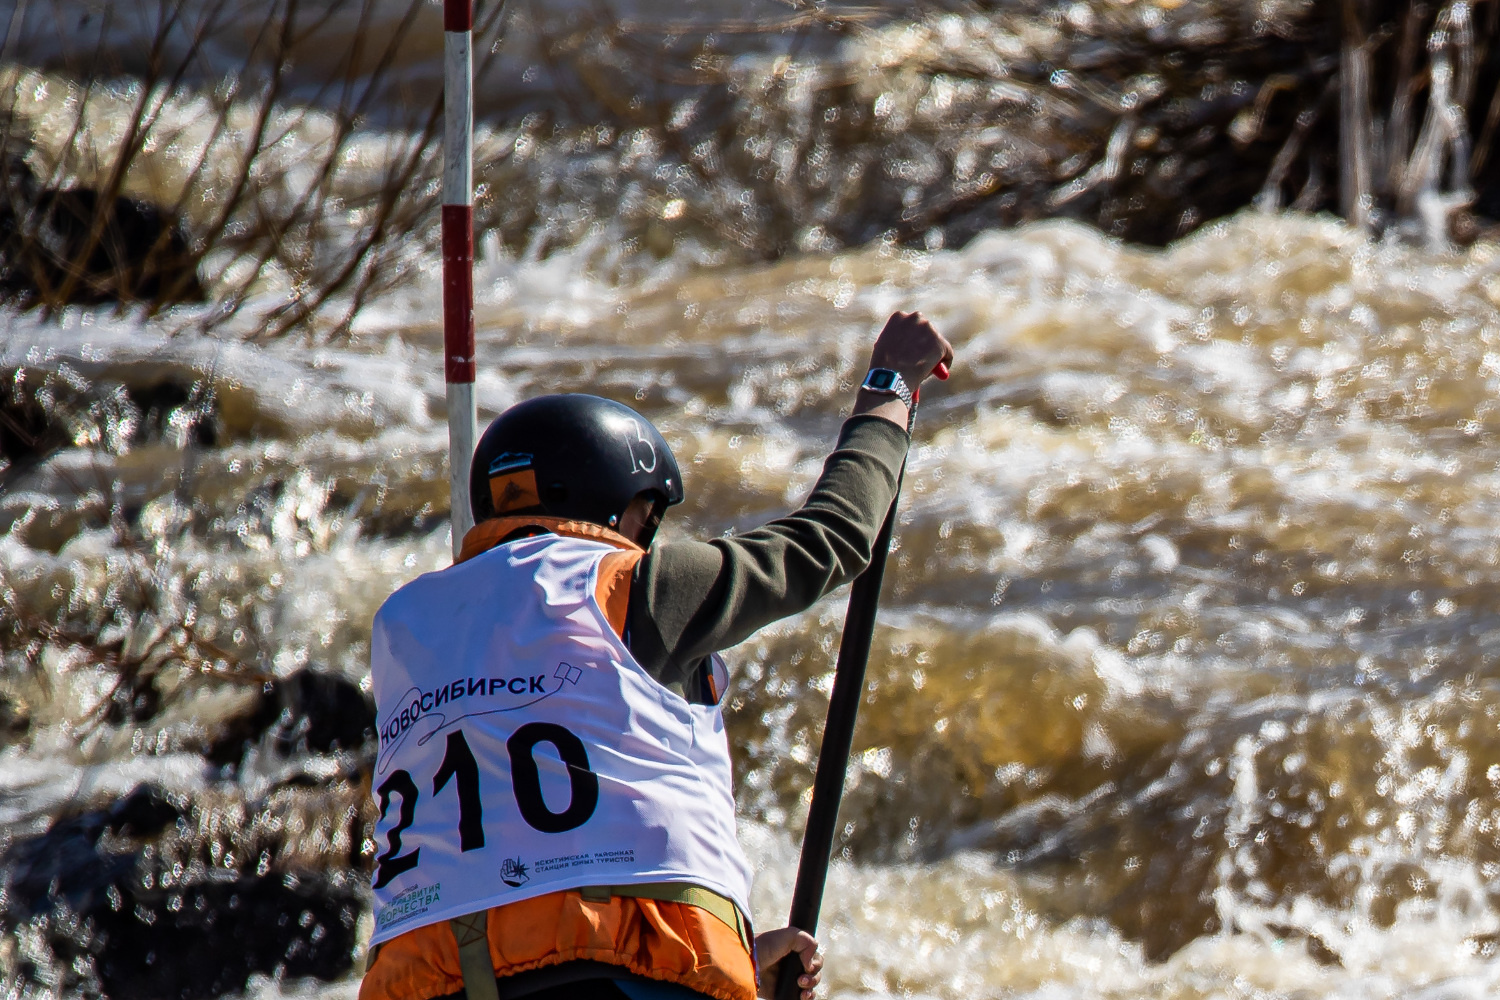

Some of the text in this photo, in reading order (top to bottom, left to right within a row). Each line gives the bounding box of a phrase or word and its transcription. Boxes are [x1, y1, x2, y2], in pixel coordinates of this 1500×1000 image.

[380, 674, 546, 749] НОВОСИБИРСК
[372, 722, 599, 890] 210
[534, 853, 589, 867] ИСКИТИМСКАЯ
[534, 856, 635, 874] СТАНЦИЯ ЮНЫХ ТУРИСТОВ
